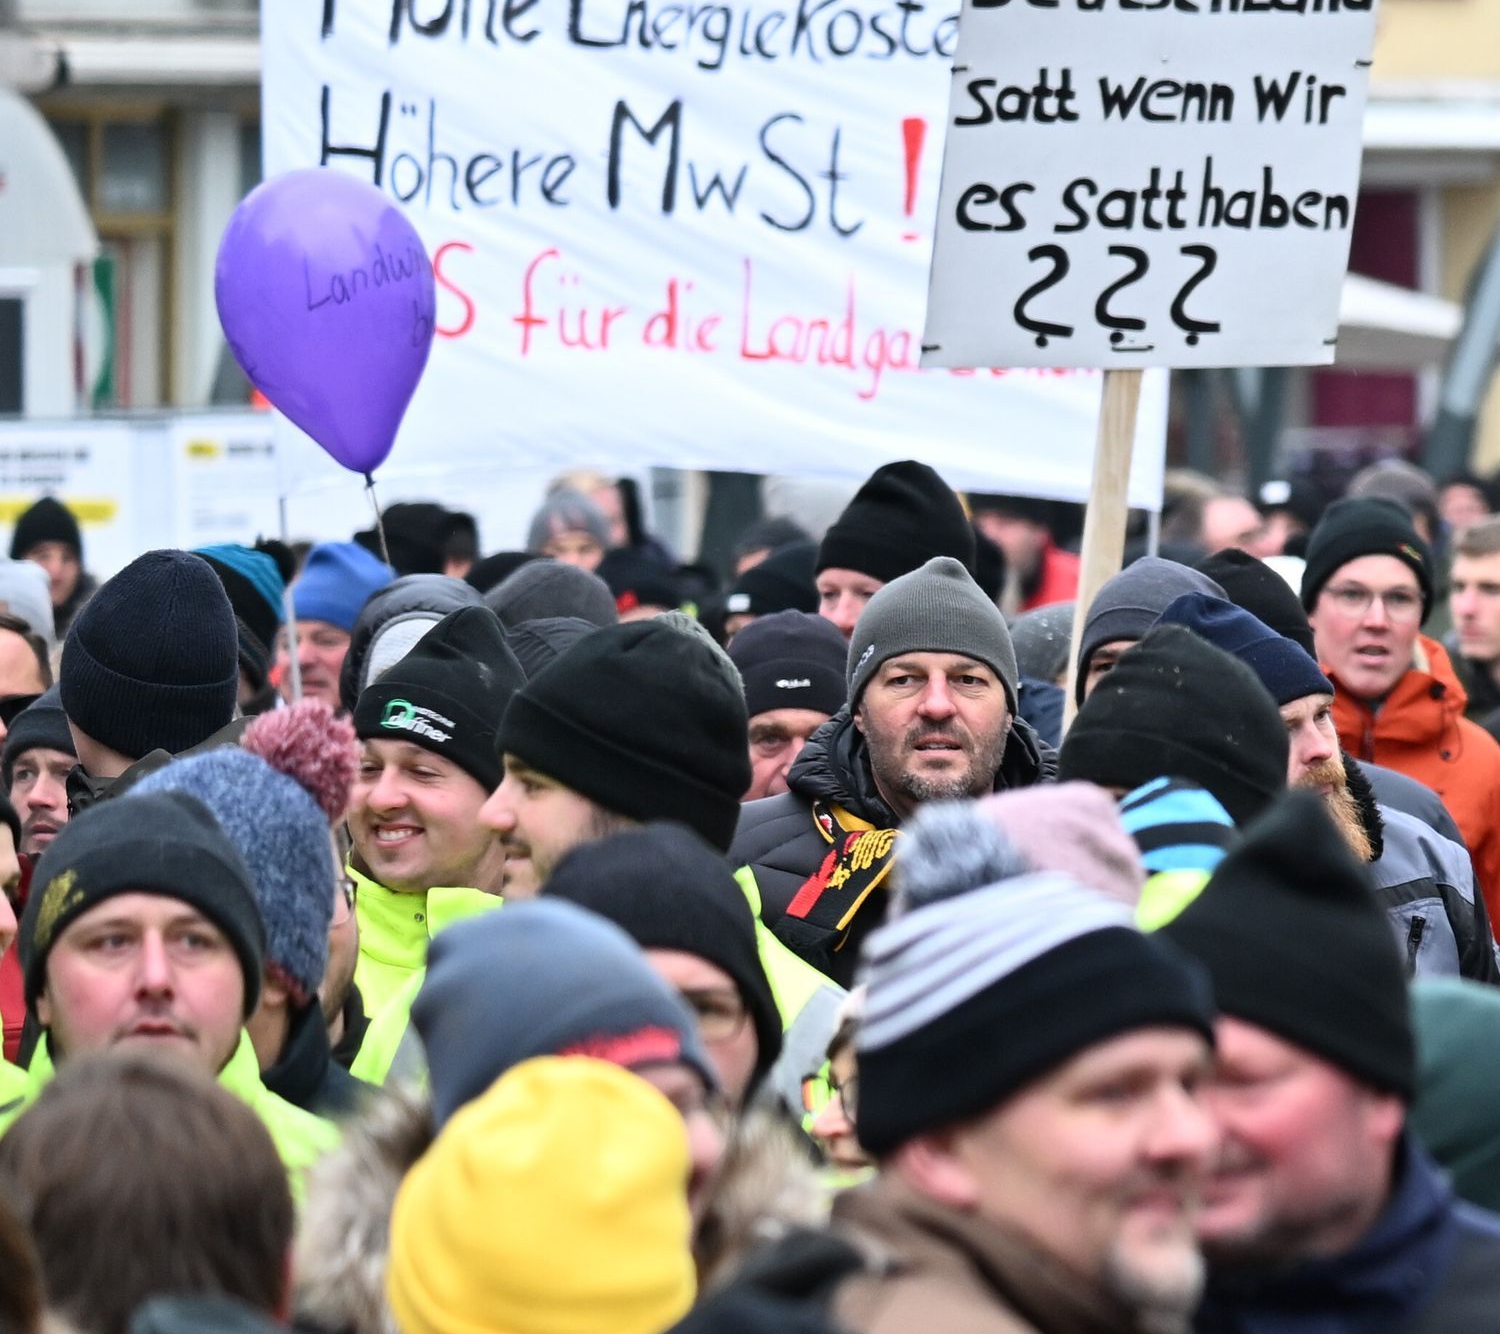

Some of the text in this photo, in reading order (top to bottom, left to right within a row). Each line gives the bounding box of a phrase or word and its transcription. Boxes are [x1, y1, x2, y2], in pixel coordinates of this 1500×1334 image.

[1100, 76, 1234, 125] wenn
[320, 84, 577, 211] Höhere
[956, 182, 1035, 232] es
[1200, 156, 1350, 231] haben
[512, 248, 631, 357] für
[642, 276, 724, 353] die
